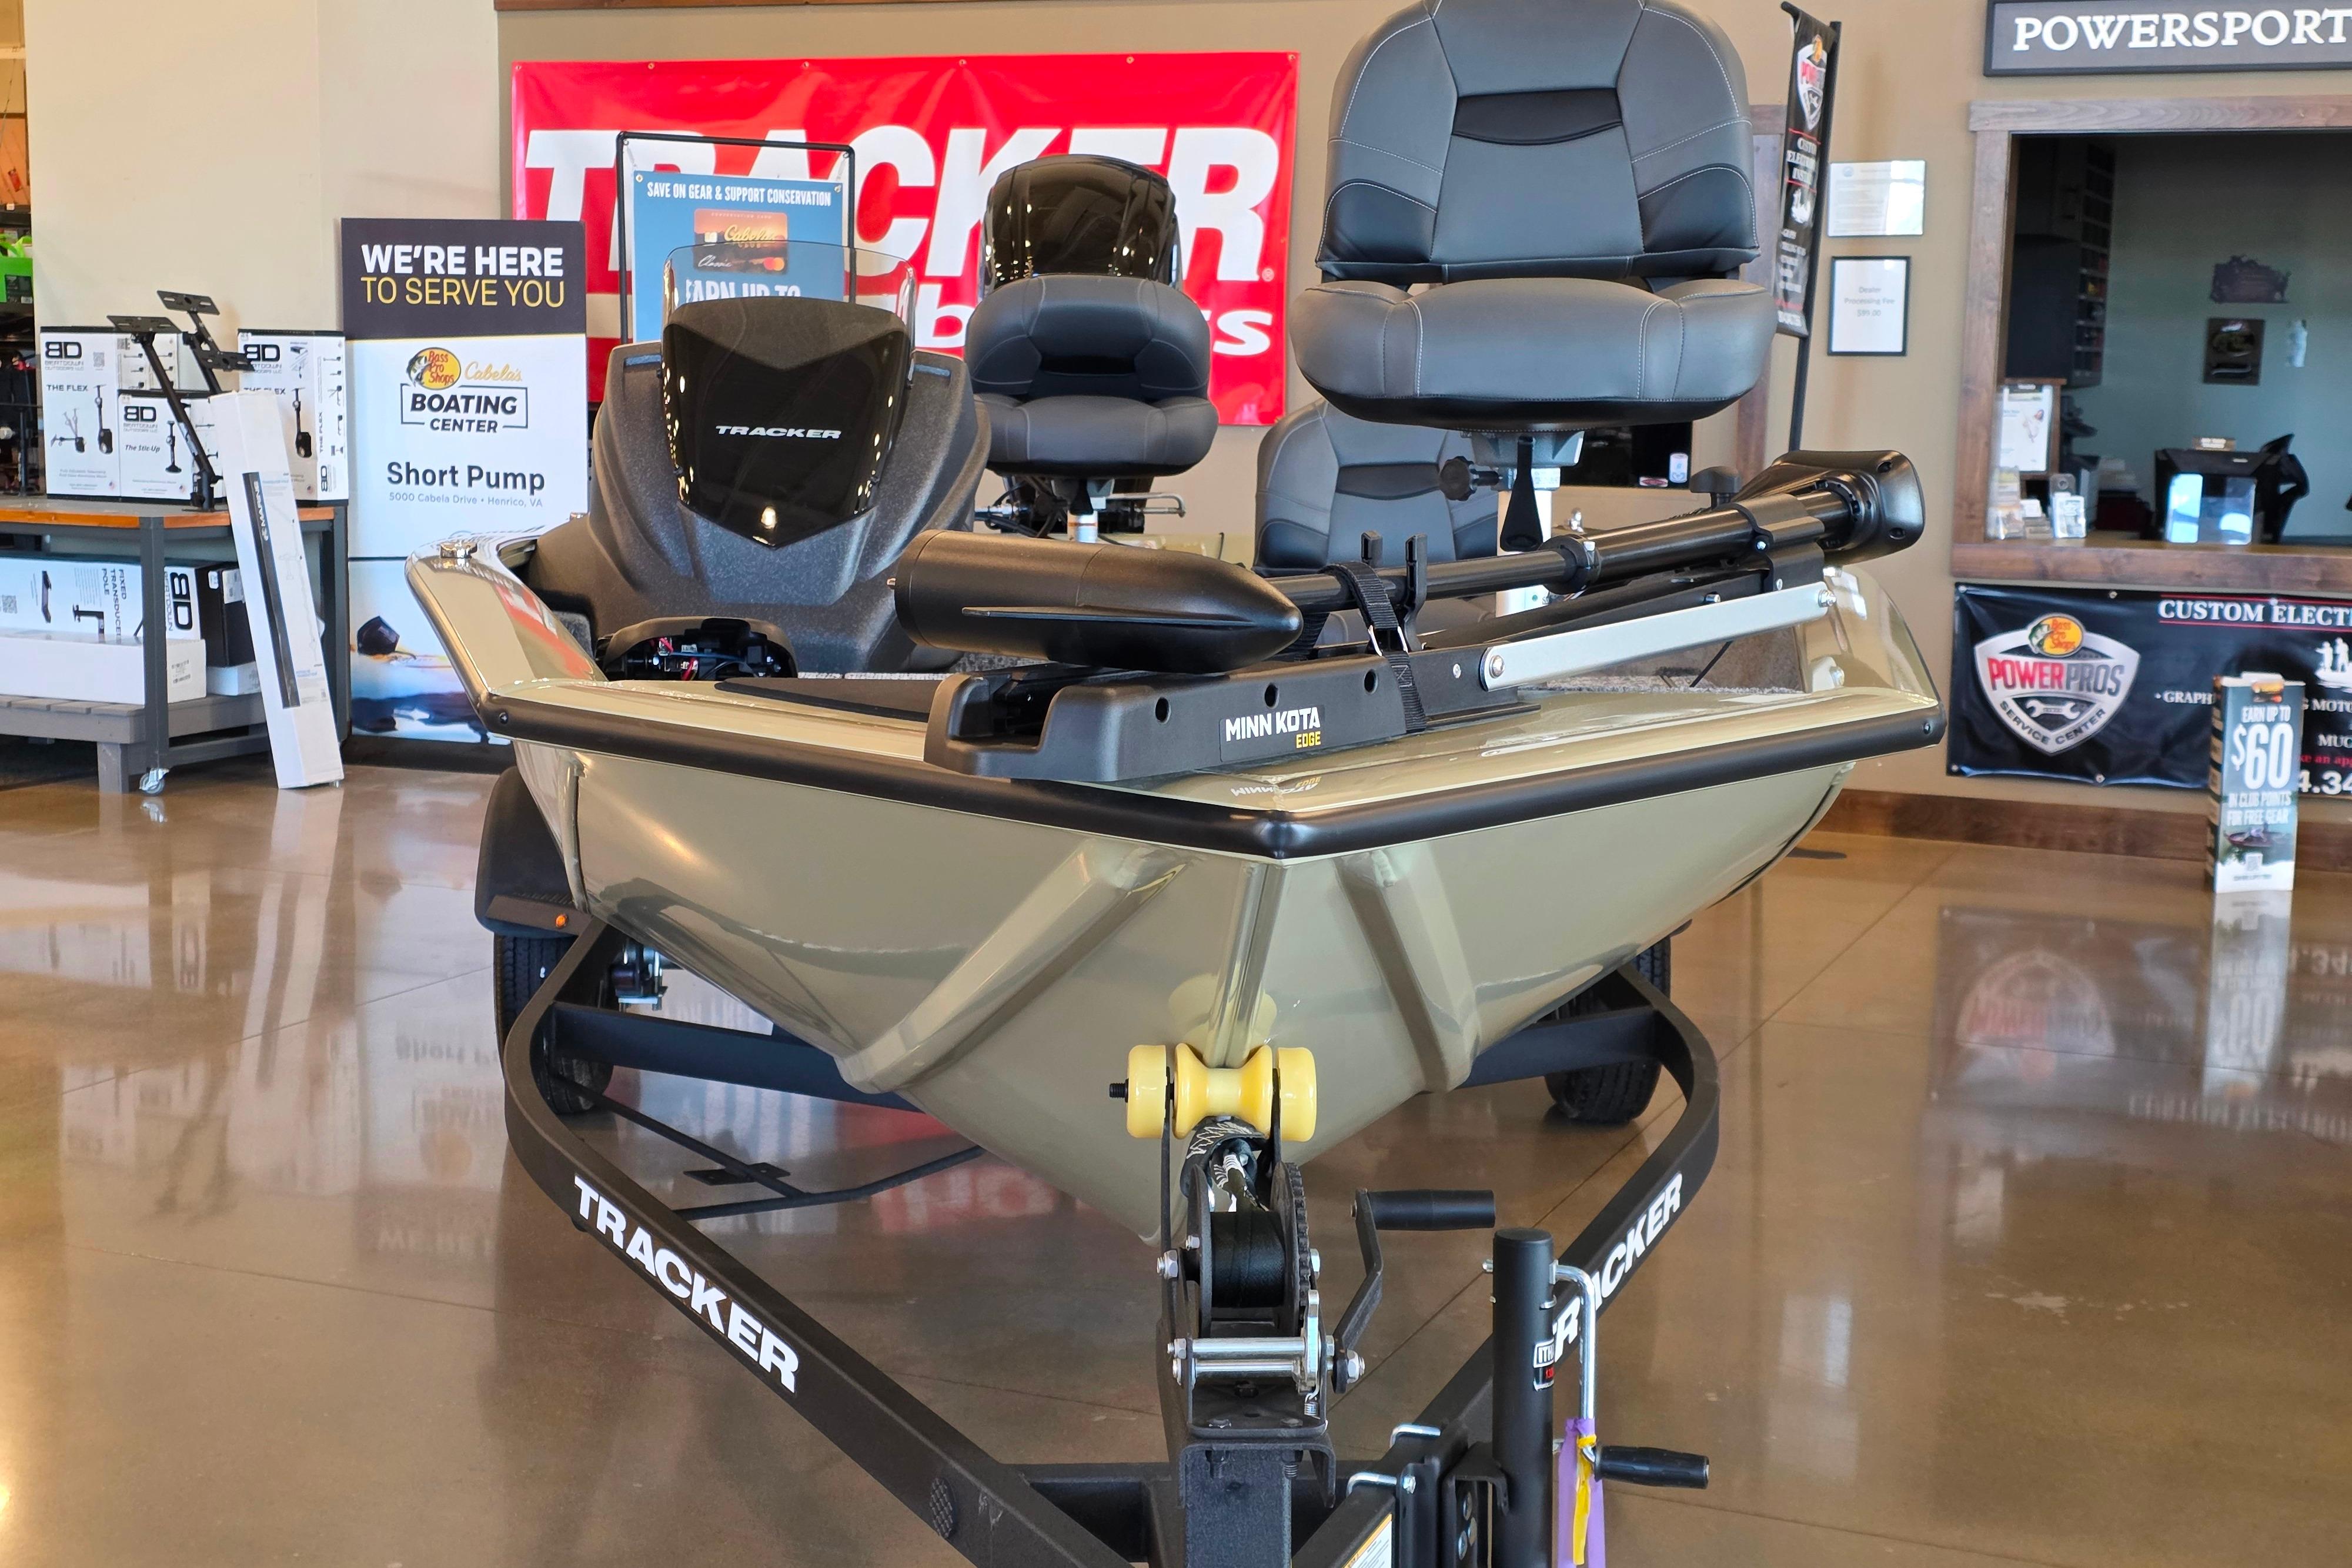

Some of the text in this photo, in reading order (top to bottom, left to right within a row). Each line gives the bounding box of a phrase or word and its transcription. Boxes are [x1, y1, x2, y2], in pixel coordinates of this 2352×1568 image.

[647, 182, 831, 206] SAVE ON GEAR & SUPPORT CONSERVATION
[361, 245, 563, 276] WE'RE HERE
[361, 276, 564, 307] TO SERVE YOU
[428, 351, 448, 362] Bass
[429, 362, 445, 372] Pro
[429, 372, 455, 386] Shops
[465, 361, 522, 382] Cabela's
[410, 393, 517, 414] BOATING
[430, 418, 498, 433] CENTER
[716, 414, 841, 439] TRACKER
[387, 462, 544, 496] Short Pump
[389, 492, 543, 508] 5000 Cabela Drive Henrico, VA
[101, 568, 109, 596] POLE
[118, 569, 127, 600] FIXED
[2158, 600, 2352, 627] CUSTOM ELECT
[1225, 707, 1321, 742] MINN KOTA
[2000, 701, 2106, 745] SERVICE CENTER
[2241, 706, 2291, 722] EARN UP TO
[1296, 731, 1321, 748] EDGE
[2231, 723, 2293, 790] $60
[2260, 791, 2291, 806] POINTS
[2227, 808, 2288, 826] FOR FREE GEAR
[574, 1175, 799, 1394] TRACKER
